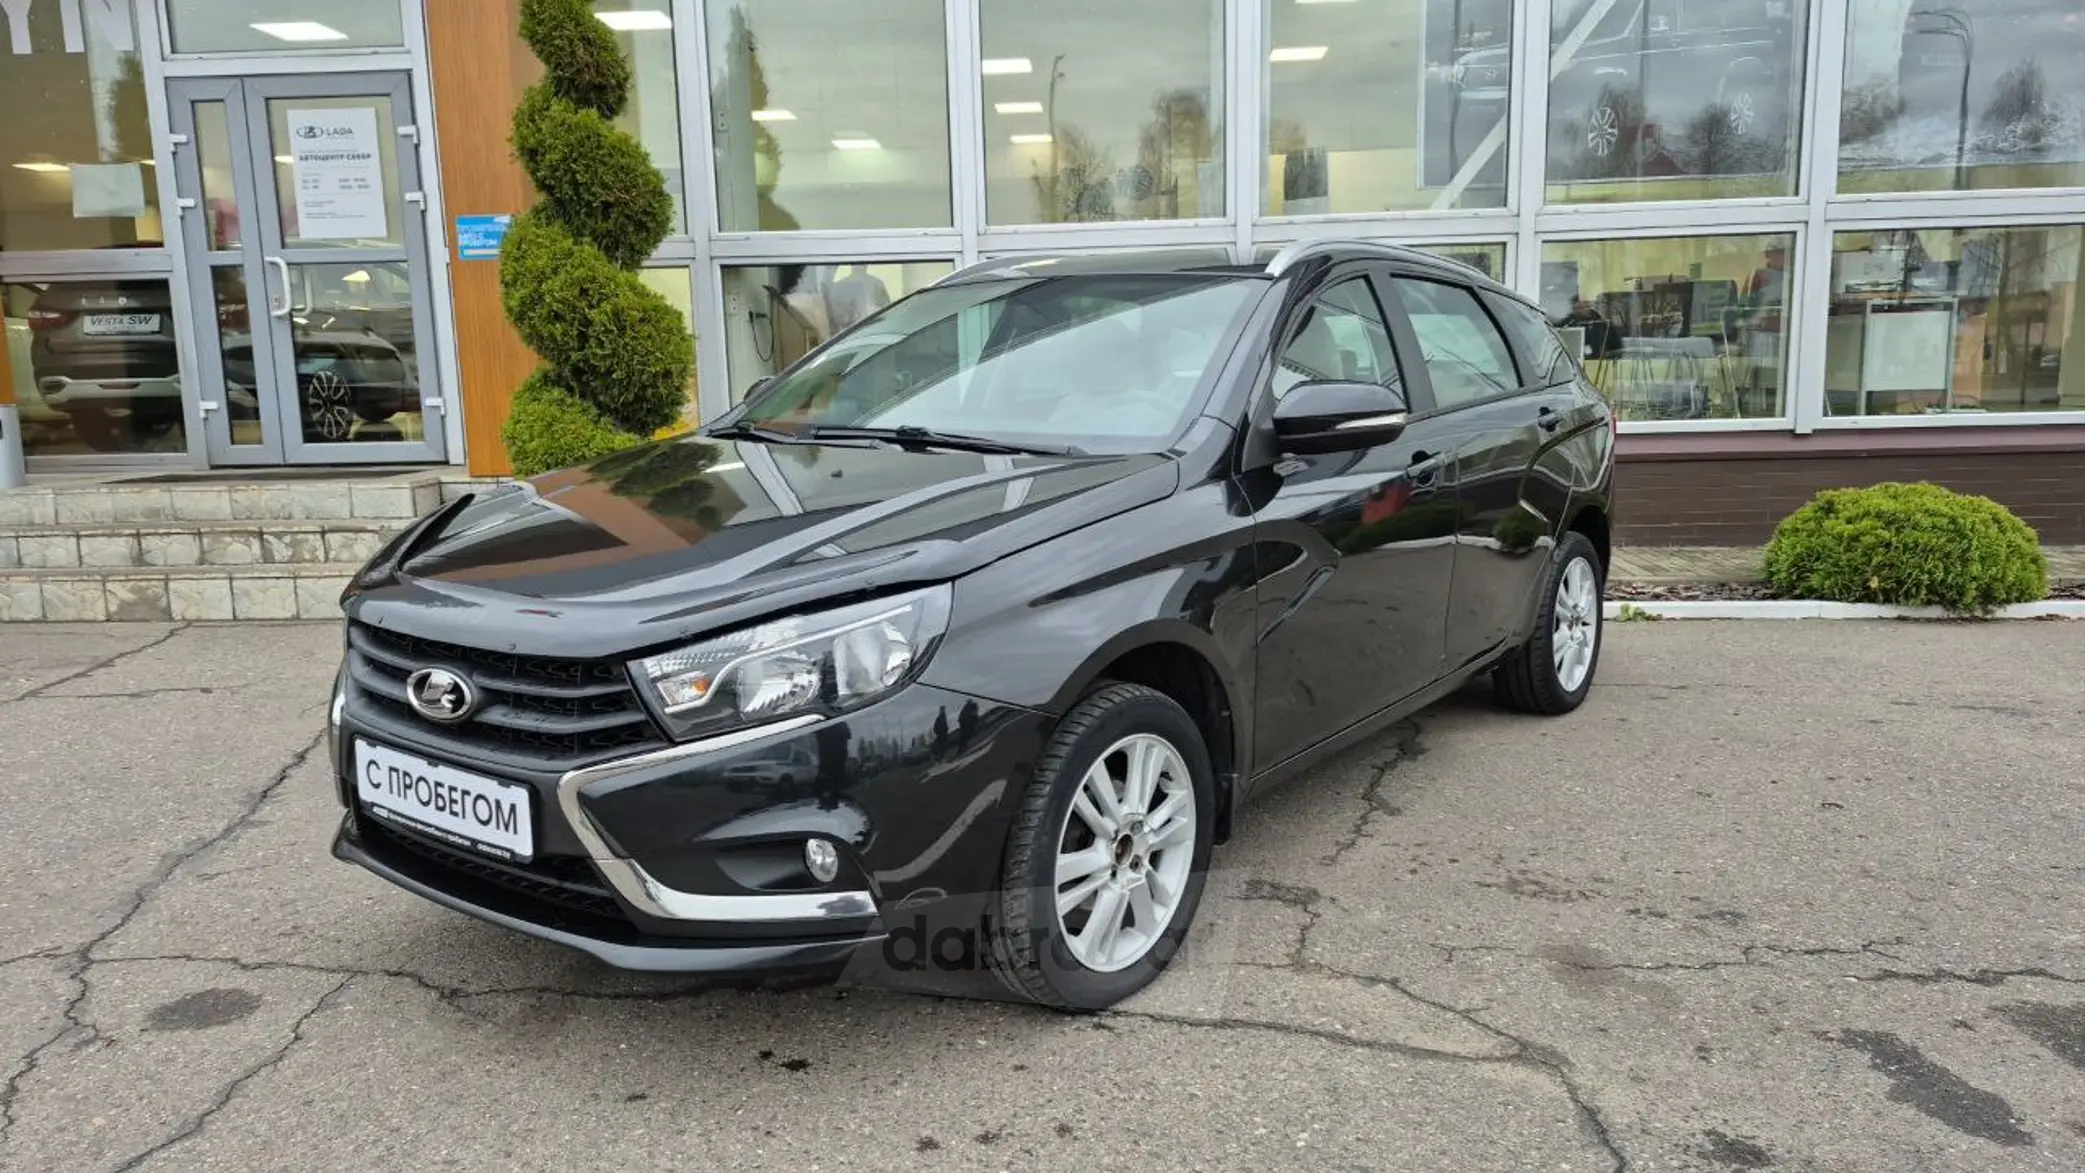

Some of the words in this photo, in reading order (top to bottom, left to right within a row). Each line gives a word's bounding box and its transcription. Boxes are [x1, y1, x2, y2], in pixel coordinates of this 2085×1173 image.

[325, 127, 353, 136] LADA
[127, 315, 153, 326] SW
[366, 758, 382, 789] С
[387, 765, 518, 835] ПРОБЕГОМ
